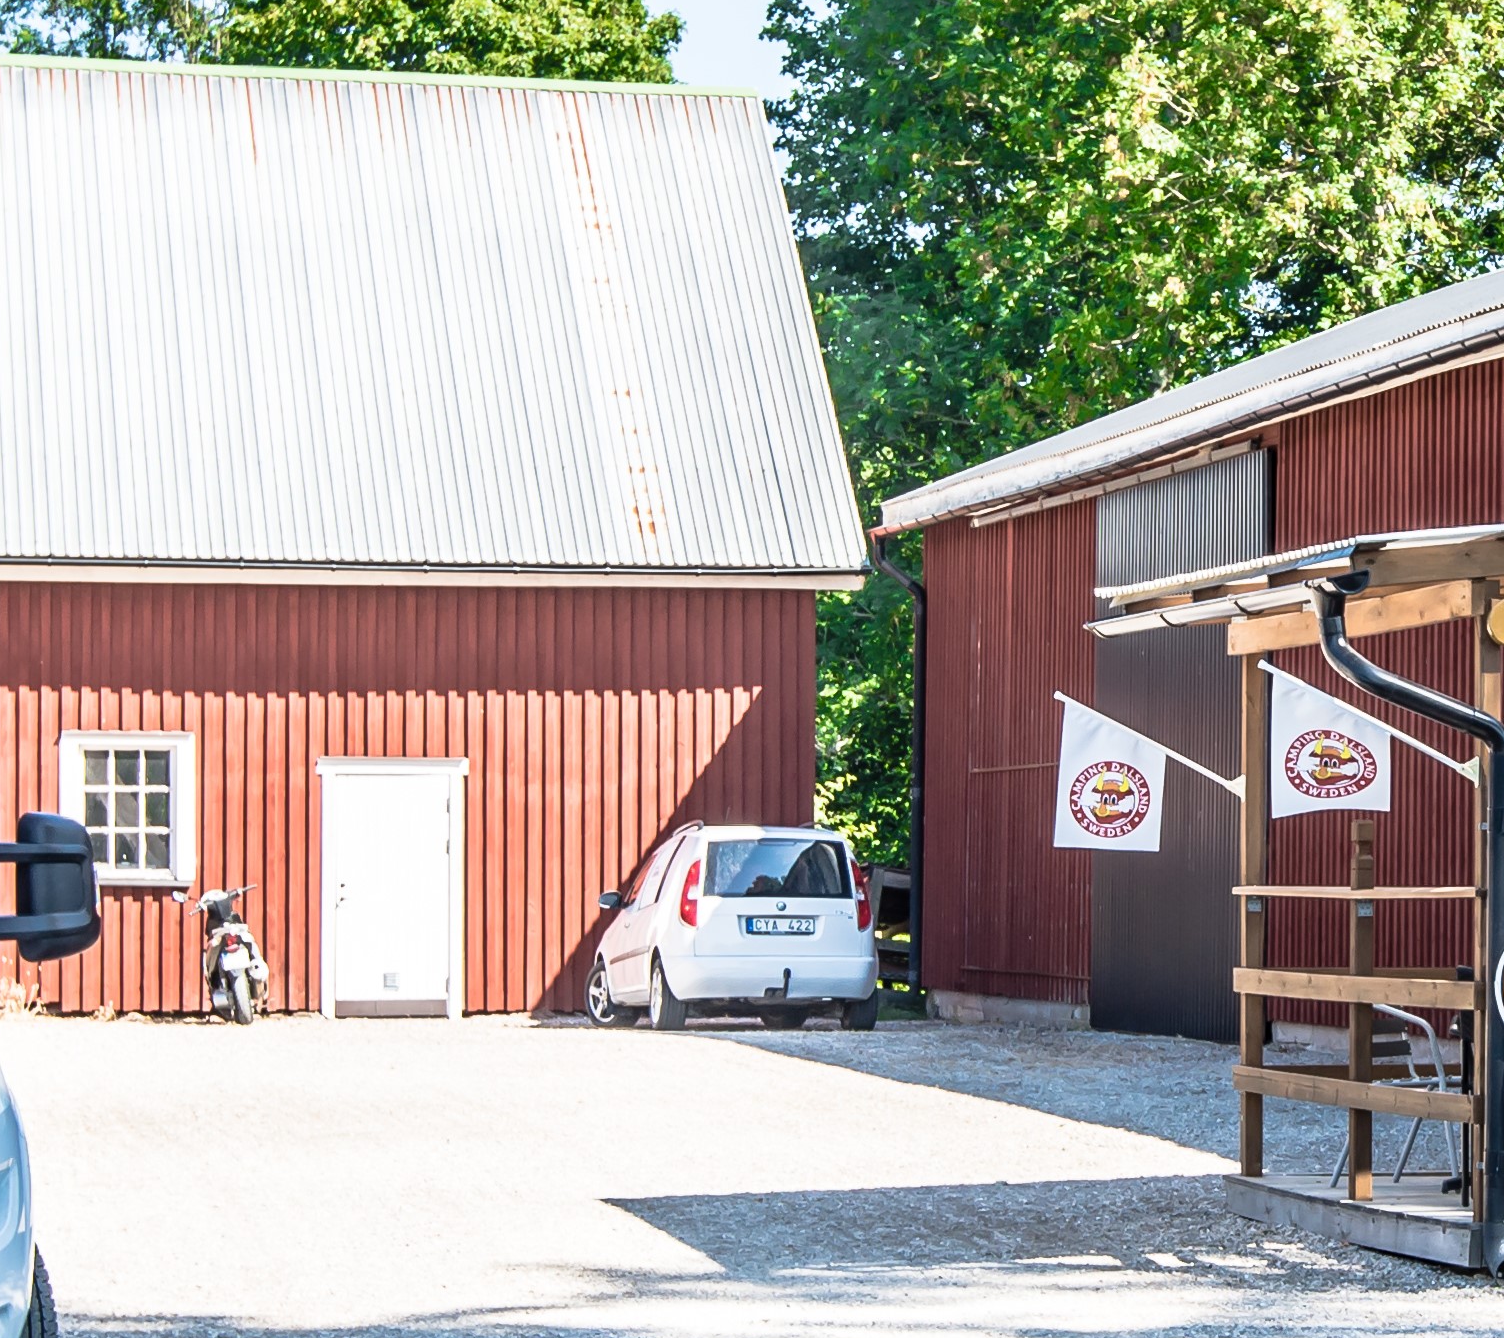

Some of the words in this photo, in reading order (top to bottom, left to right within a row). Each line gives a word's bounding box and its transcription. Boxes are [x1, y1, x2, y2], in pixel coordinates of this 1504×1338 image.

[1330, 732, 1376, 779] DALSLAND
[1110, 762, 1149, 813] DALSLAND
[1299, 782, 1359, 797] SWEDEN
[1080, 818, 1133, 837] SWEDEN
[755, 919, 778, 931] CYA
[788, 919, 812, 932] 422
